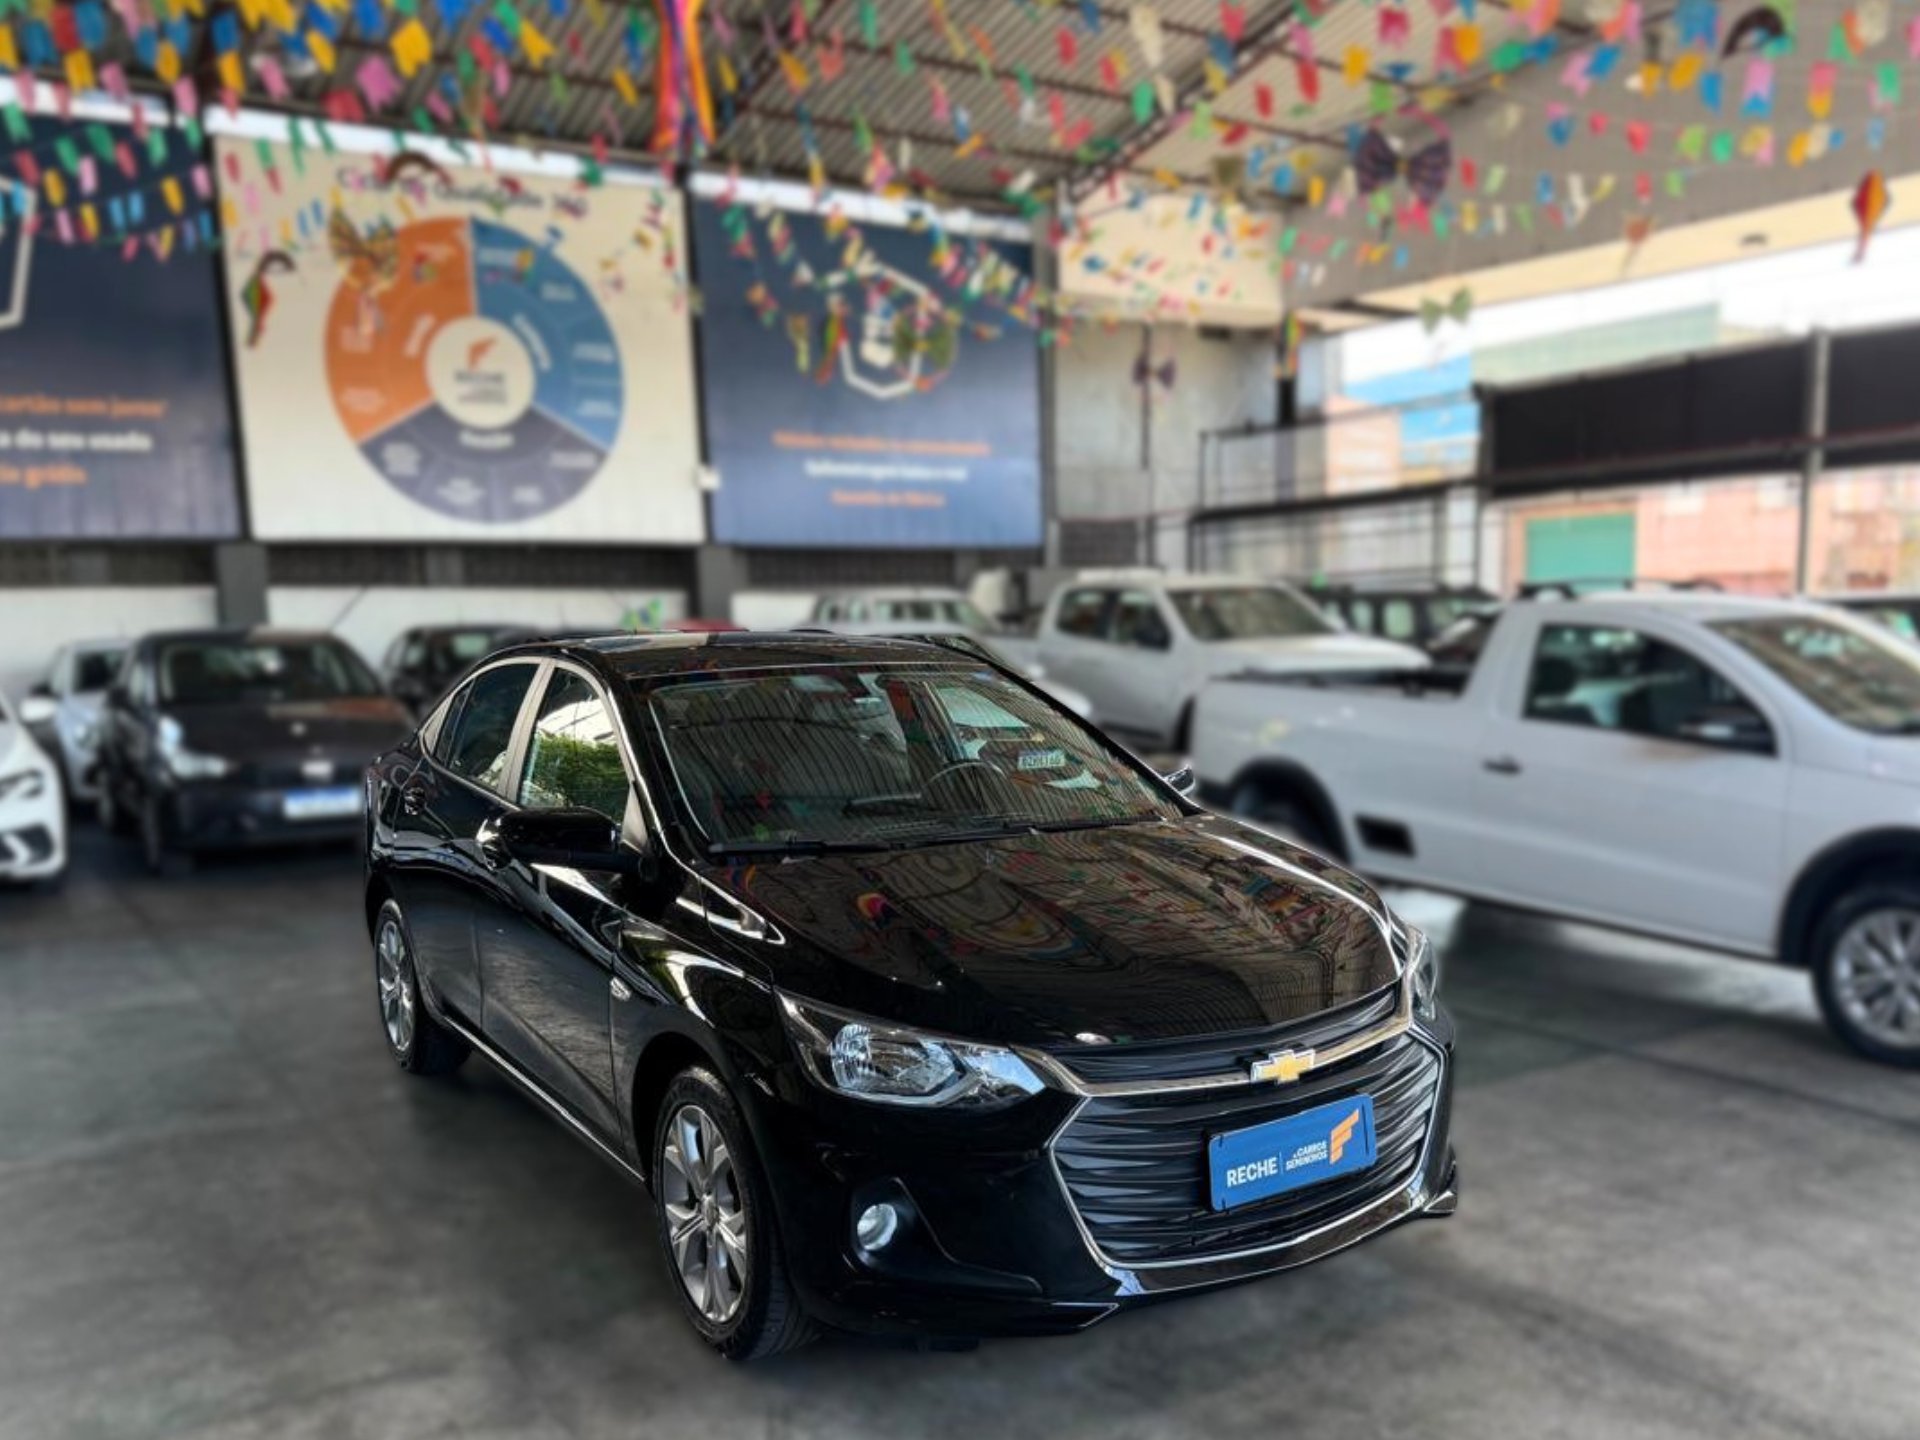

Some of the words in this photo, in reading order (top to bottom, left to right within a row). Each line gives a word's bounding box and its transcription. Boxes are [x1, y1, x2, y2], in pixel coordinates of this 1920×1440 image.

[1297, 1140, 1327, 1158] CARROS
[1226, 1156, 1279, 1188] RECHE
[1285, 1151, 1328, 1172] SEMINOVOS
